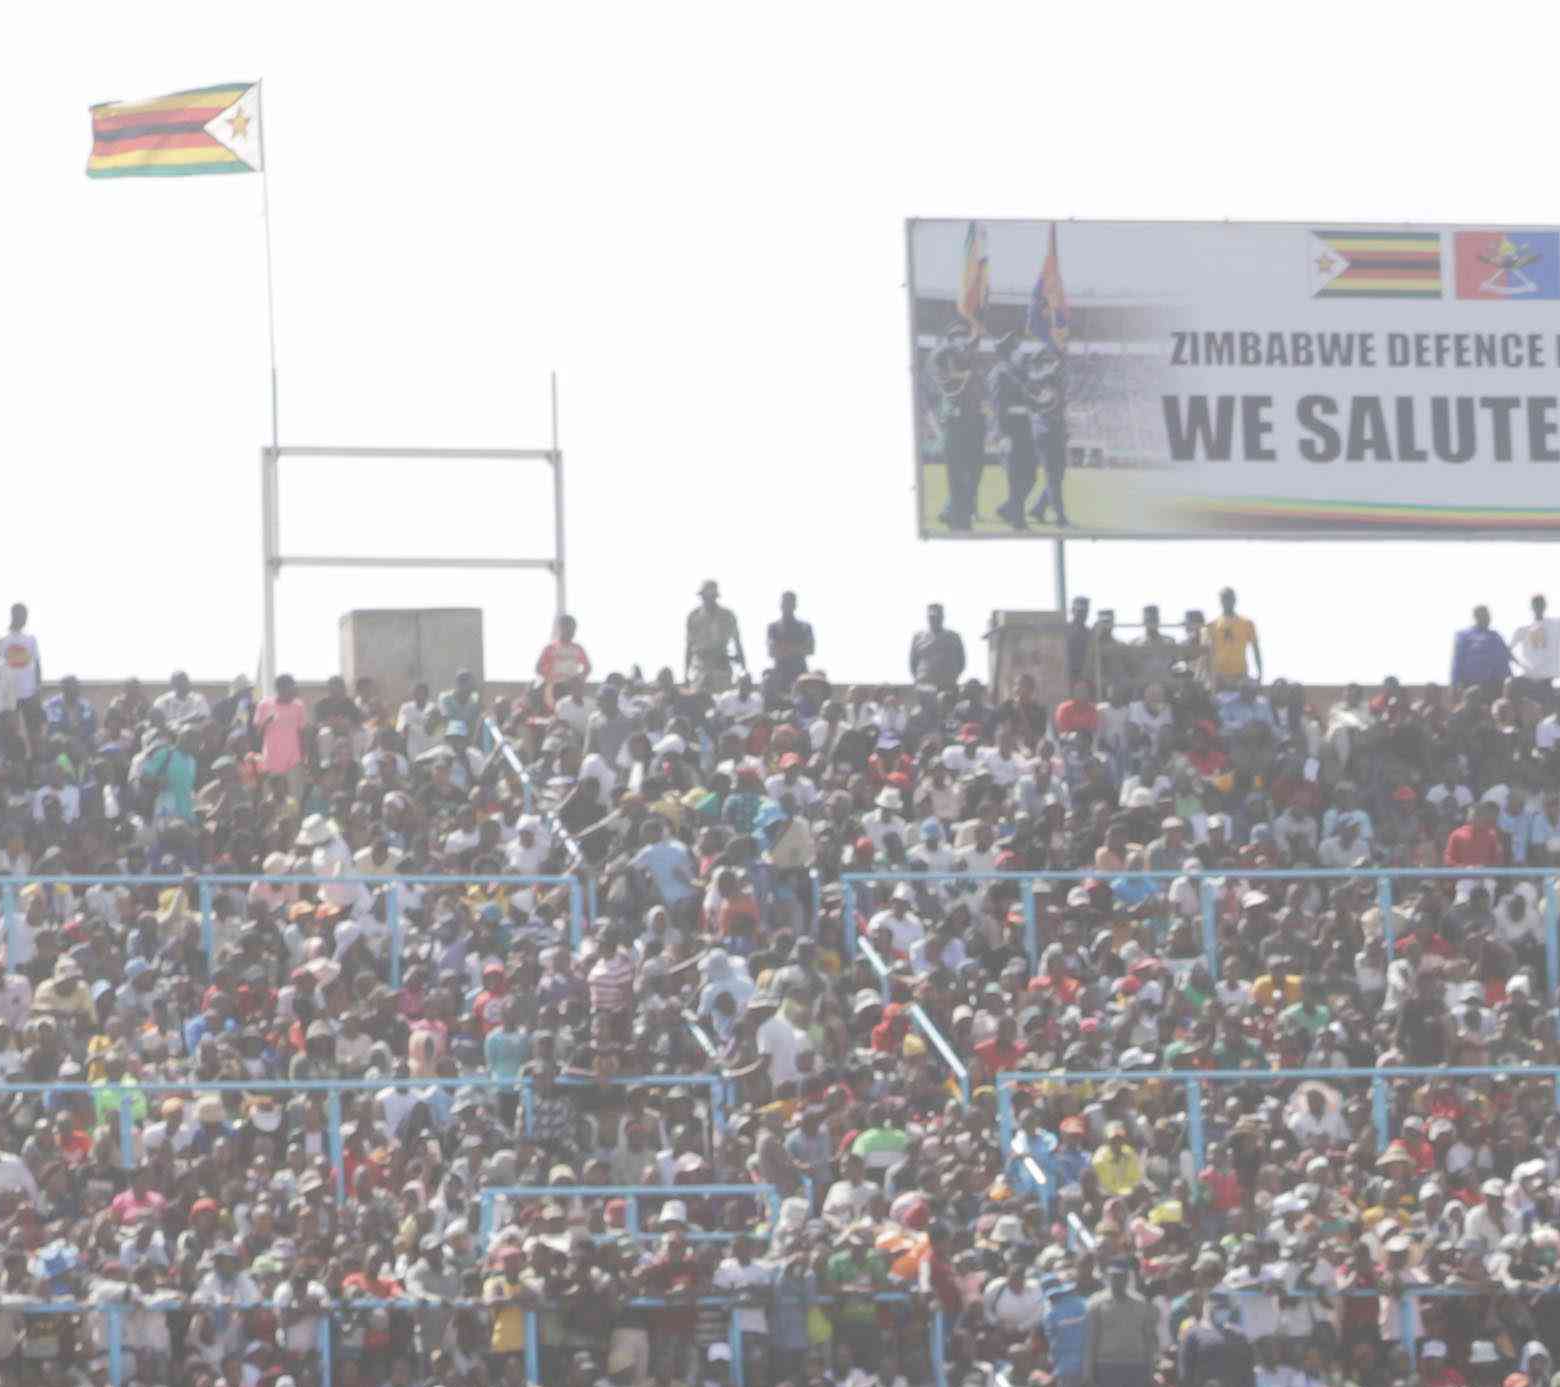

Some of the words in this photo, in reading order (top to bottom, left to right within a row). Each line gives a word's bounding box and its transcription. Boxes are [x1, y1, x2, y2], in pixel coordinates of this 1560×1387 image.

[1170, 330, 1376, 367] ZIMBABWE
[1388, 332, 1544, 369] DEFENCE
[1162, 394, 1280, 463] WE
